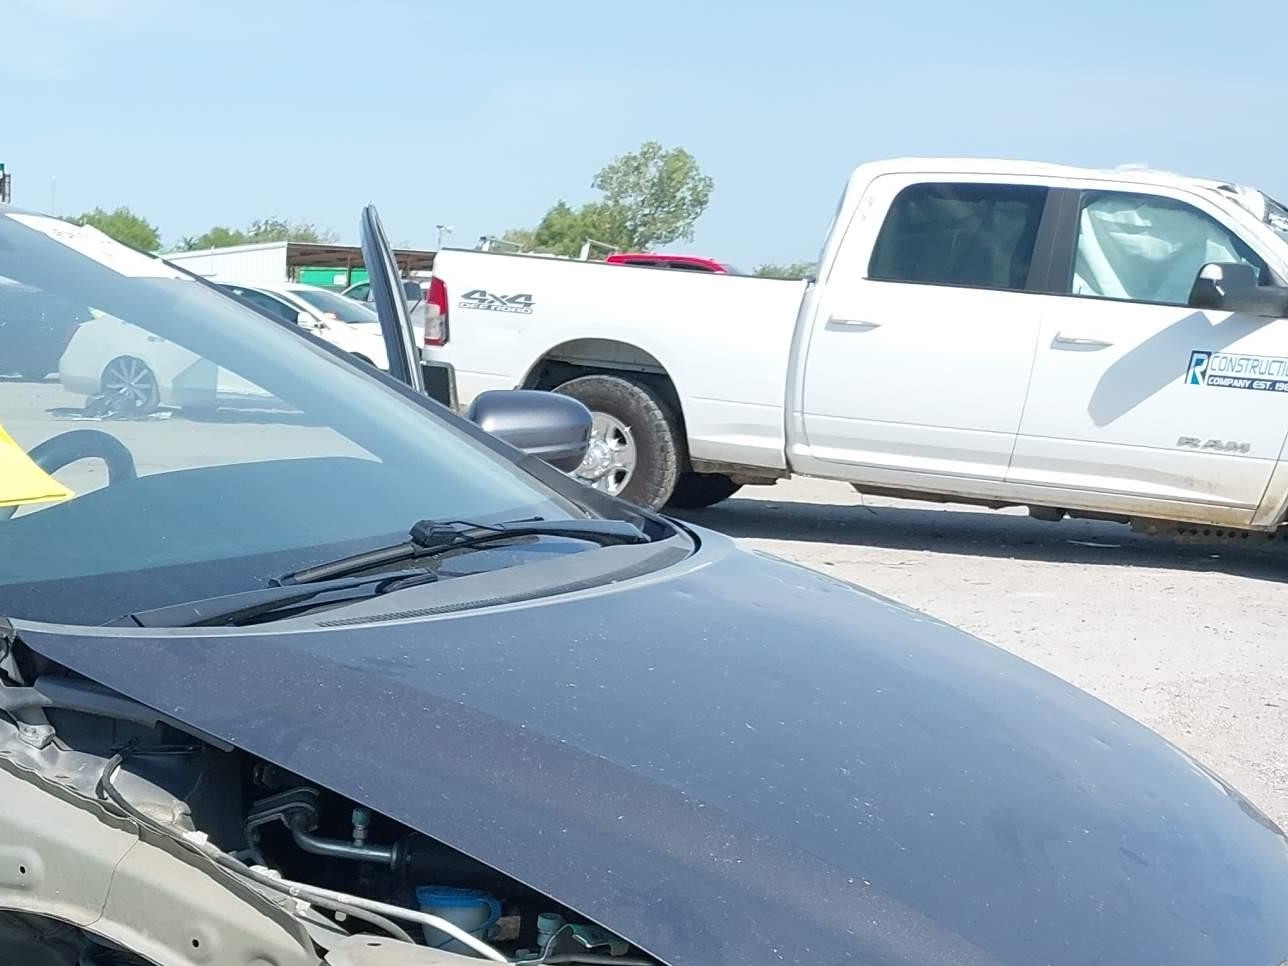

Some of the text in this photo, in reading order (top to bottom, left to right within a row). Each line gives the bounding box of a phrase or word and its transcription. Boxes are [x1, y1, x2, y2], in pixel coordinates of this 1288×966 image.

[1208, 376, 1253, 388] COMPANY
[1252, 380, 1273, 390] EST.
[1176, 436, 1251, 454] RAM
